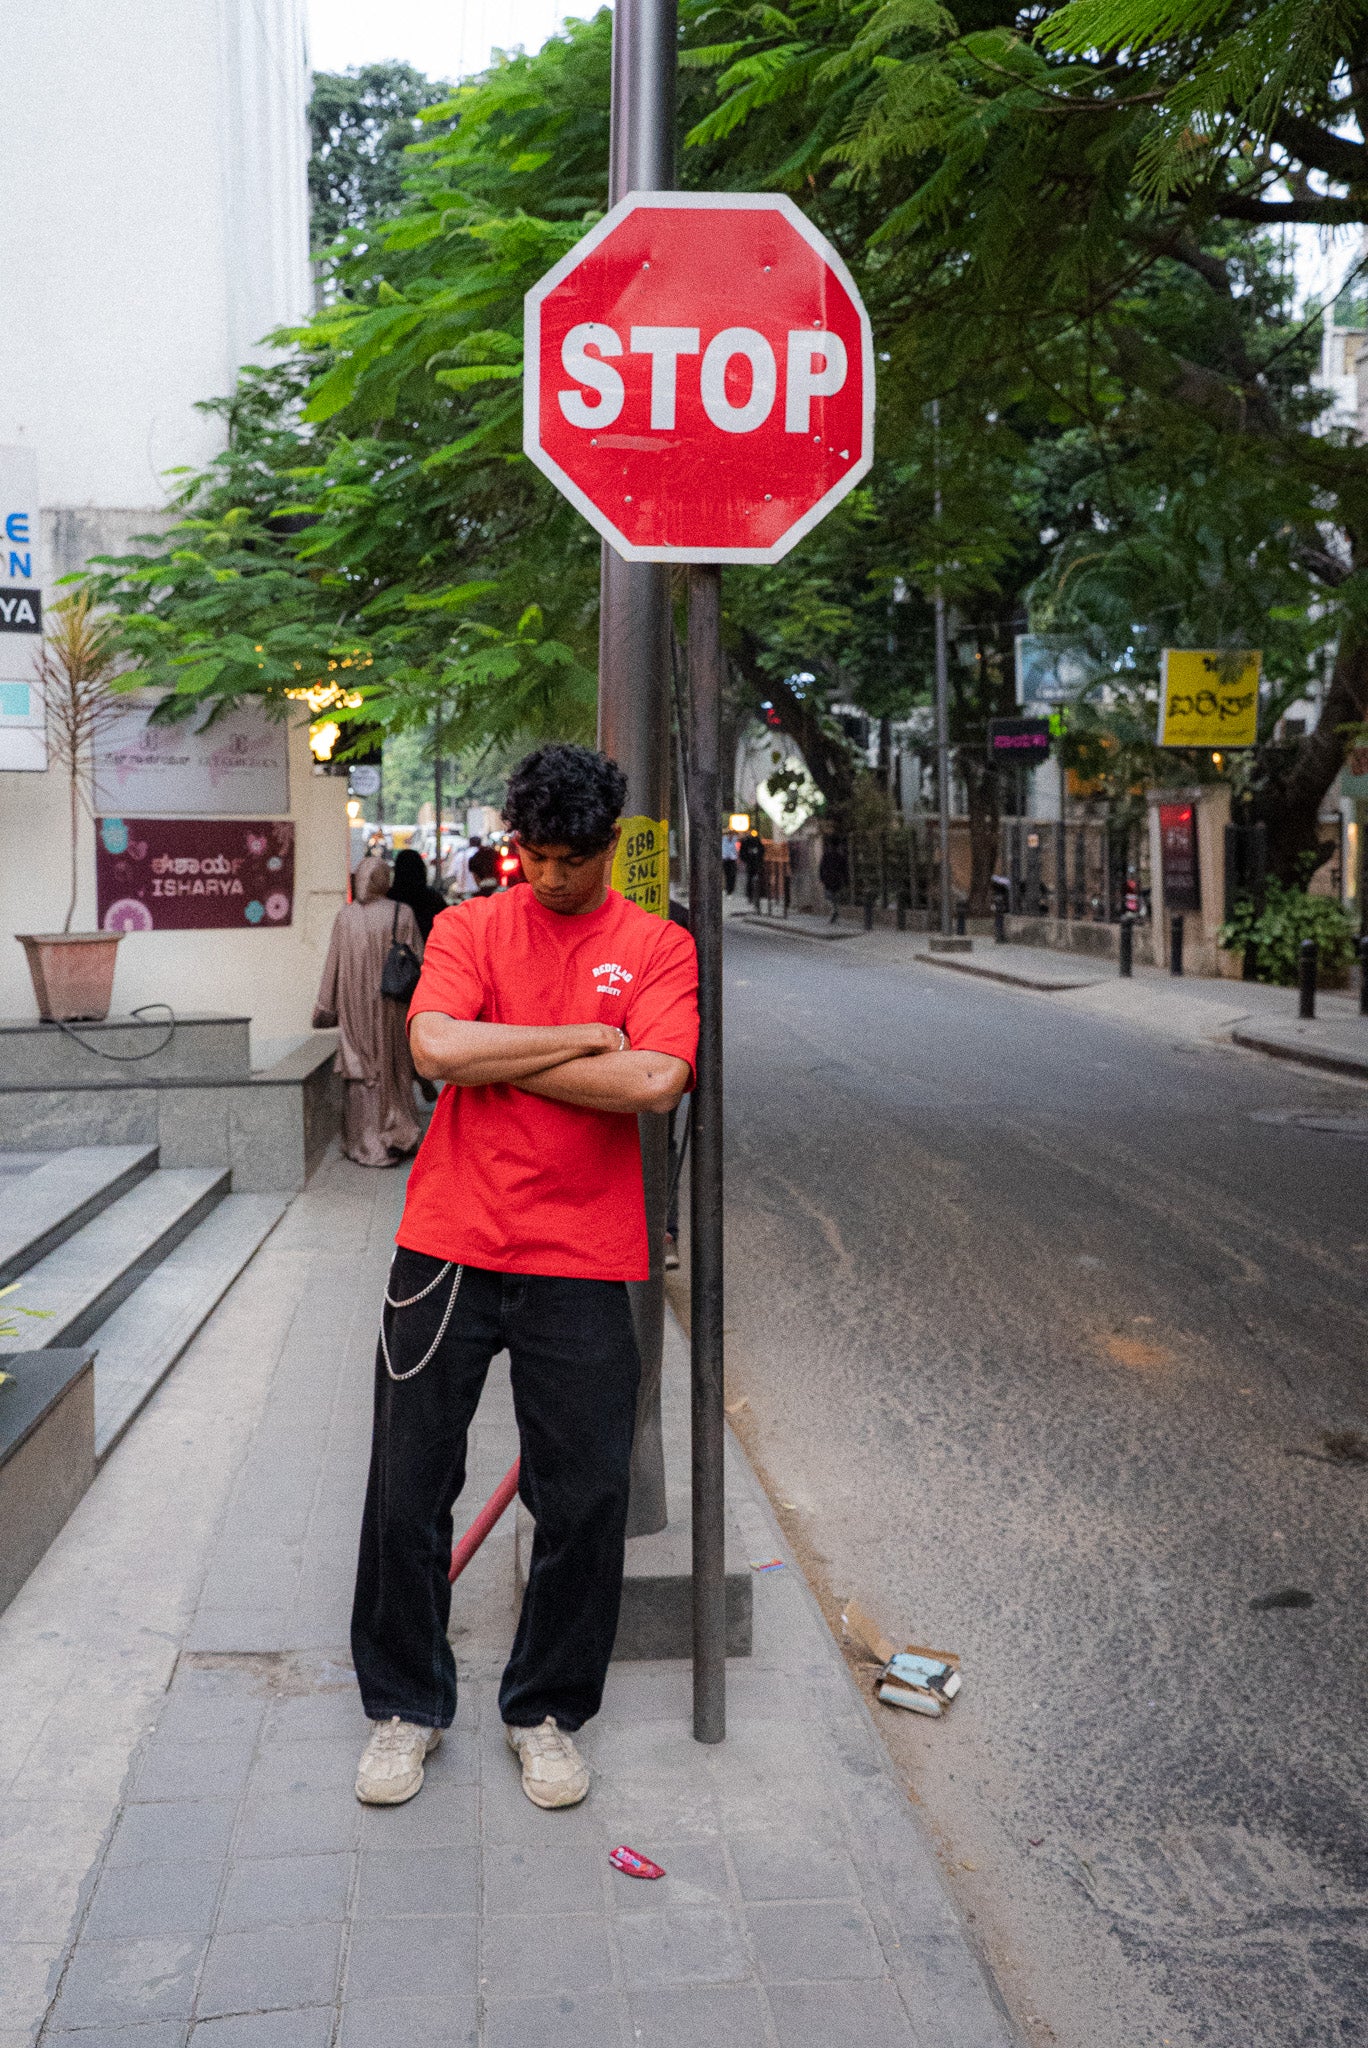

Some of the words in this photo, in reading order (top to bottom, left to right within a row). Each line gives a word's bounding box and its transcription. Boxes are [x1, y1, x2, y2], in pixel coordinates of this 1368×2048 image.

[558, 321, 848, 434] STOP
[627, 860, 658, 883] SNL
[152, 879, 244, 897] ISHARYA
